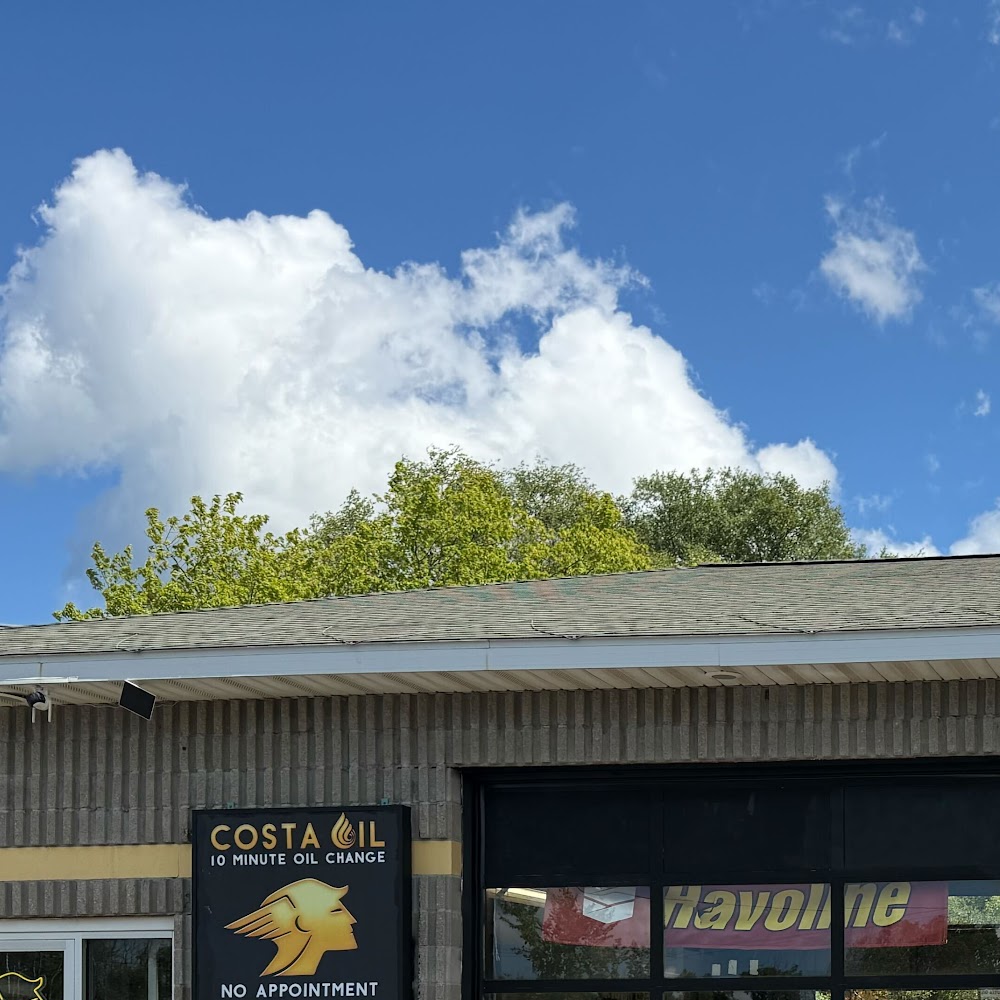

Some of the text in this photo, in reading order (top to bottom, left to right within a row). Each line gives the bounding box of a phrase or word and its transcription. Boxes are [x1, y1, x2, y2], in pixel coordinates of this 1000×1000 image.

[210, 812, 385, 850] COSTA OIL
[211, 851, 386, 866] 10 MINUTE OIL CHANGE
[221, 982, 379, 998] NO APPOINTMENT
